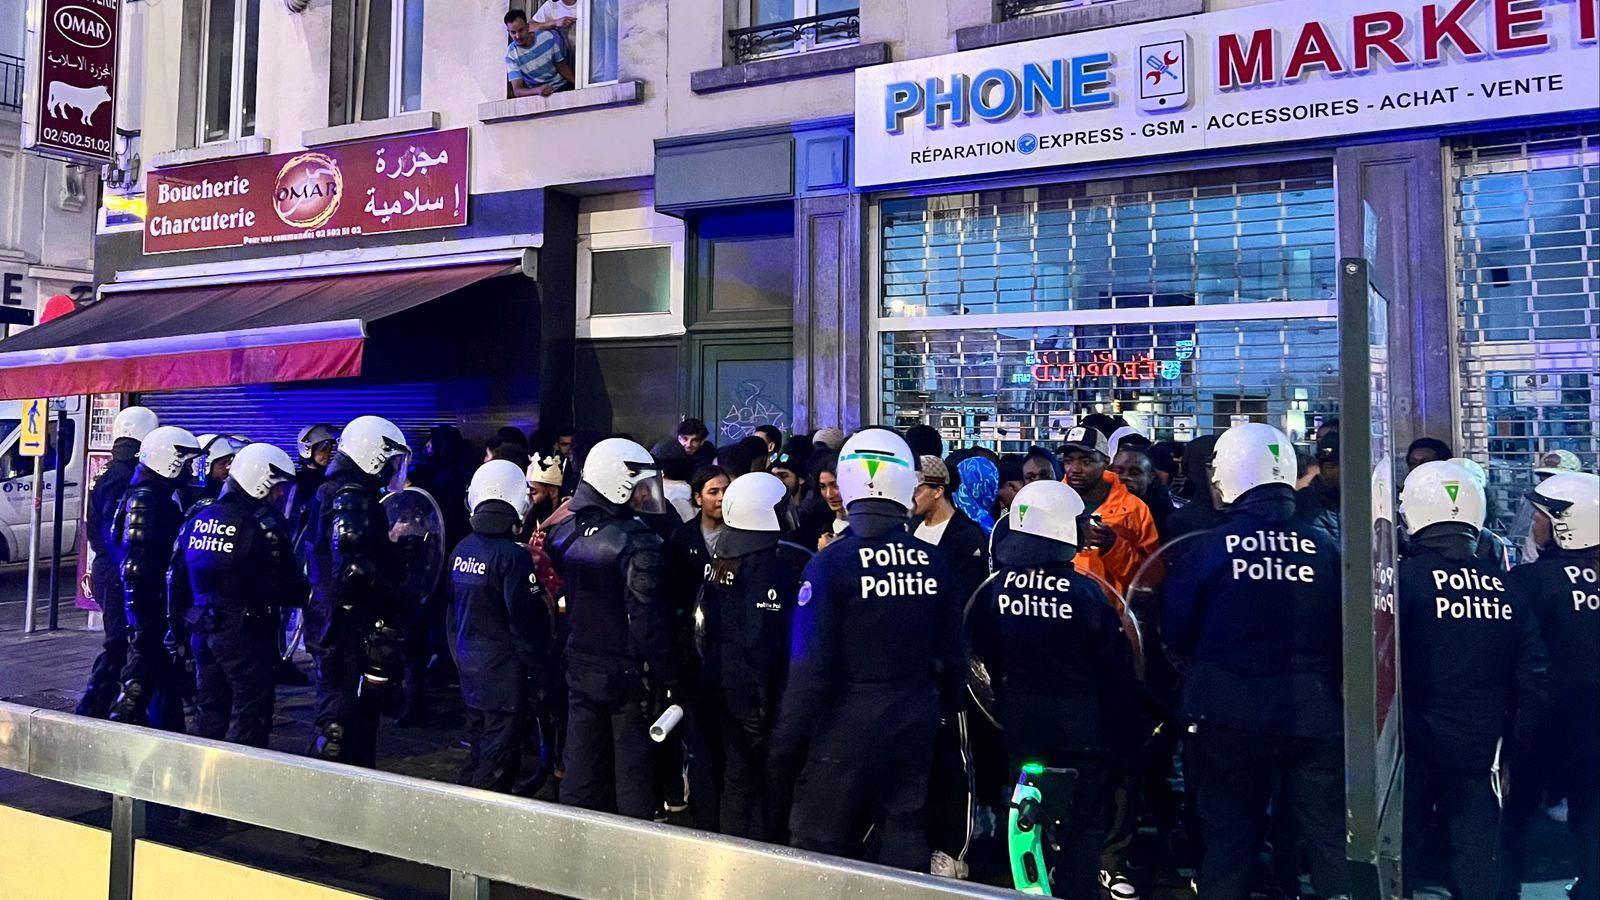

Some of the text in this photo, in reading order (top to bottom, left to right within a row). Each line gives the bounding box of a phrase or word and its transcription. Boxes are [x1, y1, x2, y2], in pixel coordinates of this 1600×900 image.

[60, 12, 105, 40] OMAR
[884, 52, 1113, 134] PHONE
[910, 138, 1015, 165] RÉPARATION
[1039, 127, 1124, 150] EXPRESS
[1142, 119, 1185, 138] GSM
[1206, 98, 1360, 131] ACCESSOIRES
[1379, 86, 1460, 112] ACHAT
[1480, 73, 1564, 99] VENTE
[43, 127, 111, 153] 02/502.51.02
[375, 145, 449, 179] مجزرة
[157, 175, 251, 204] Boucherie
[277, 181, 338, 201] OMAR
[149, 207, 256, 237] Charcuterie
[327, 229, 341, 237] 502
[193, 518, 237, 536] Police
[188, 536, 234, 553] Politie
[858, 542, 930, 568] Police
[1225, 530, 1317, 554] Politie
[452, 556, 486, 575] Police
[1232, 557, 1315, 583] Police
[860, 571, 938, 599] Politie
[1003, 570, 1071, 592] Police
[1432, 567, 1505, 592] Police
[998, 594, 1073, 620] Politie
[1435, 596, 1513, 620] Politie
